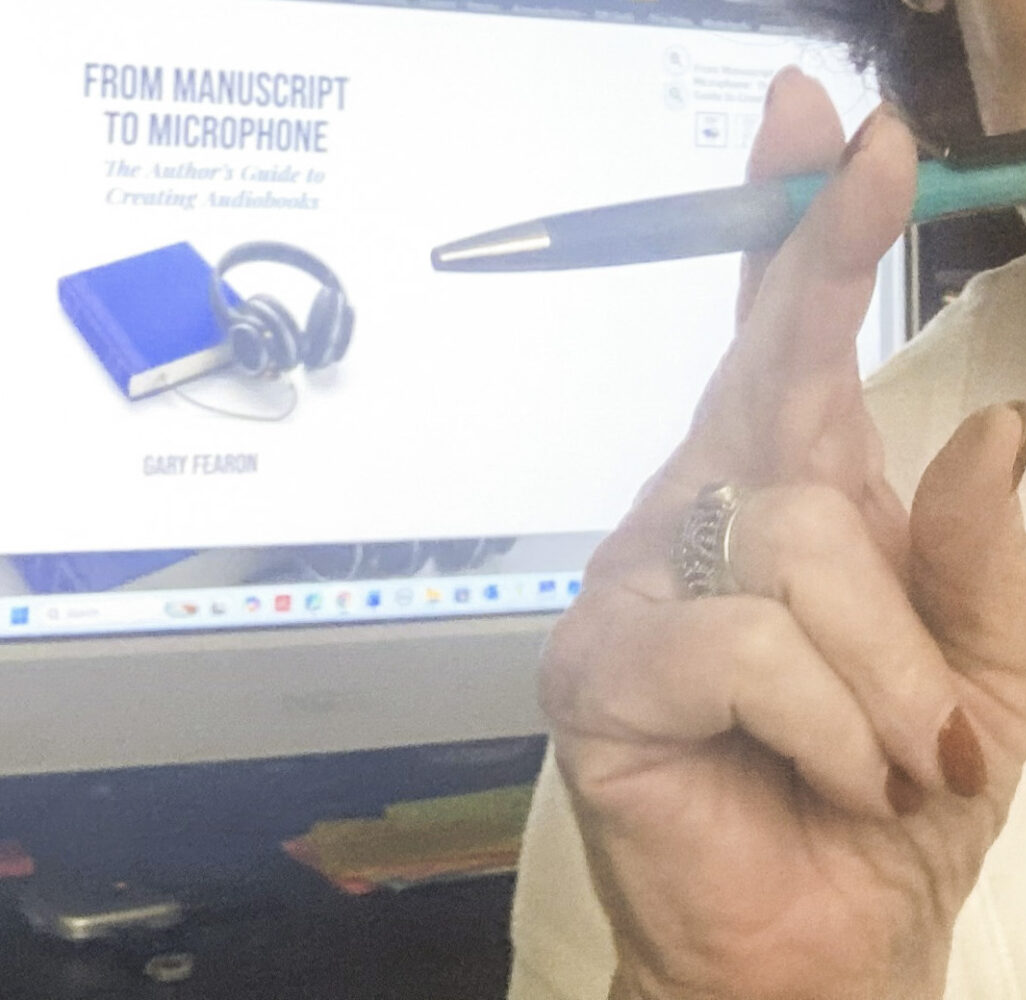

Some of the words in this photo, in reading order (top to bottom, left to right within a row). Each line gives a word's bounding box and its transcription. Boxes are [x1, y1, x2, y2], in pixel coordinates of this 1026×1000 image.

[84, 62, 163, 101] FROM
[173, 67, 349, 111] MANUSCRIPT
[103, 110, 139, 146] TO
[148, 113, 328, 153] MICROPHONE
[105, 159, 142, 178] The
[146, 161, 234, 182] Author's
[240, 165, 301, 184] Guide
[305, 167, 326, 184] to
[105, 187, 198, 210] Creating
[201, 190, 320, 211] Audiobooks
[142, 454, 189, 477] GARY
[191, 452, 259, 476] FEARON
